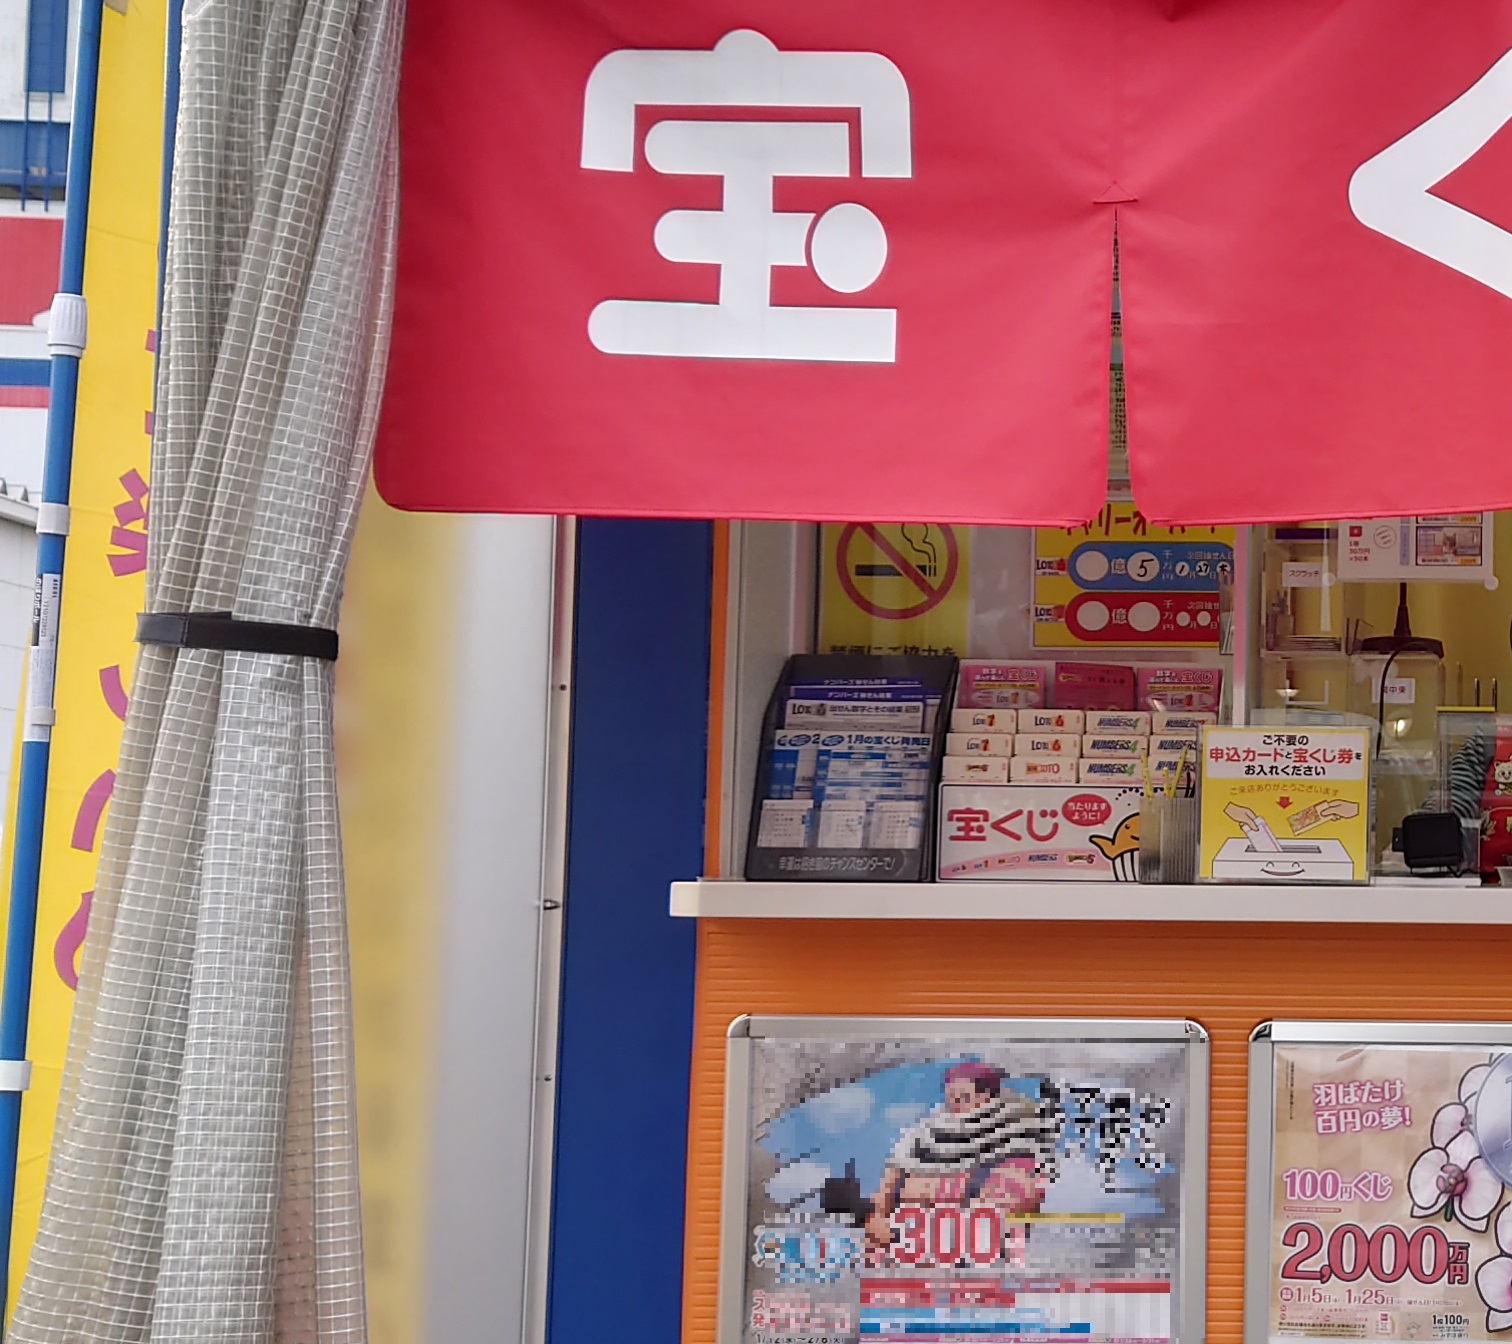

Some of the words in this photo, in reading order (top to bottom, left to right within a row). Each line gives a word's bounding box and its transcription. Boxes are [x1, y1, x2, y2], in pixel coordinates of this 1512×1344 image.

[1137, 558, 1155, 578] 5
[1262, 734, 1309, 746] ご不要の
[1209, 747, 1363, 765] 申込カードと宝くじ券を
[1244, 764, 1326, 777] お入れください
[947, 807, 1060, 843] 宝くじ
[1313, 1079, 1405, 1107] 羽ばたけ
[1315, 1105, 1413, 1134] 百円の夢!
[1283, 1168, 1394, 1202] 100円くじ
[1281, 1221, 1471, 1285] 2,000万円
[1431, 1314, 1470, 1326] 1枚100円
